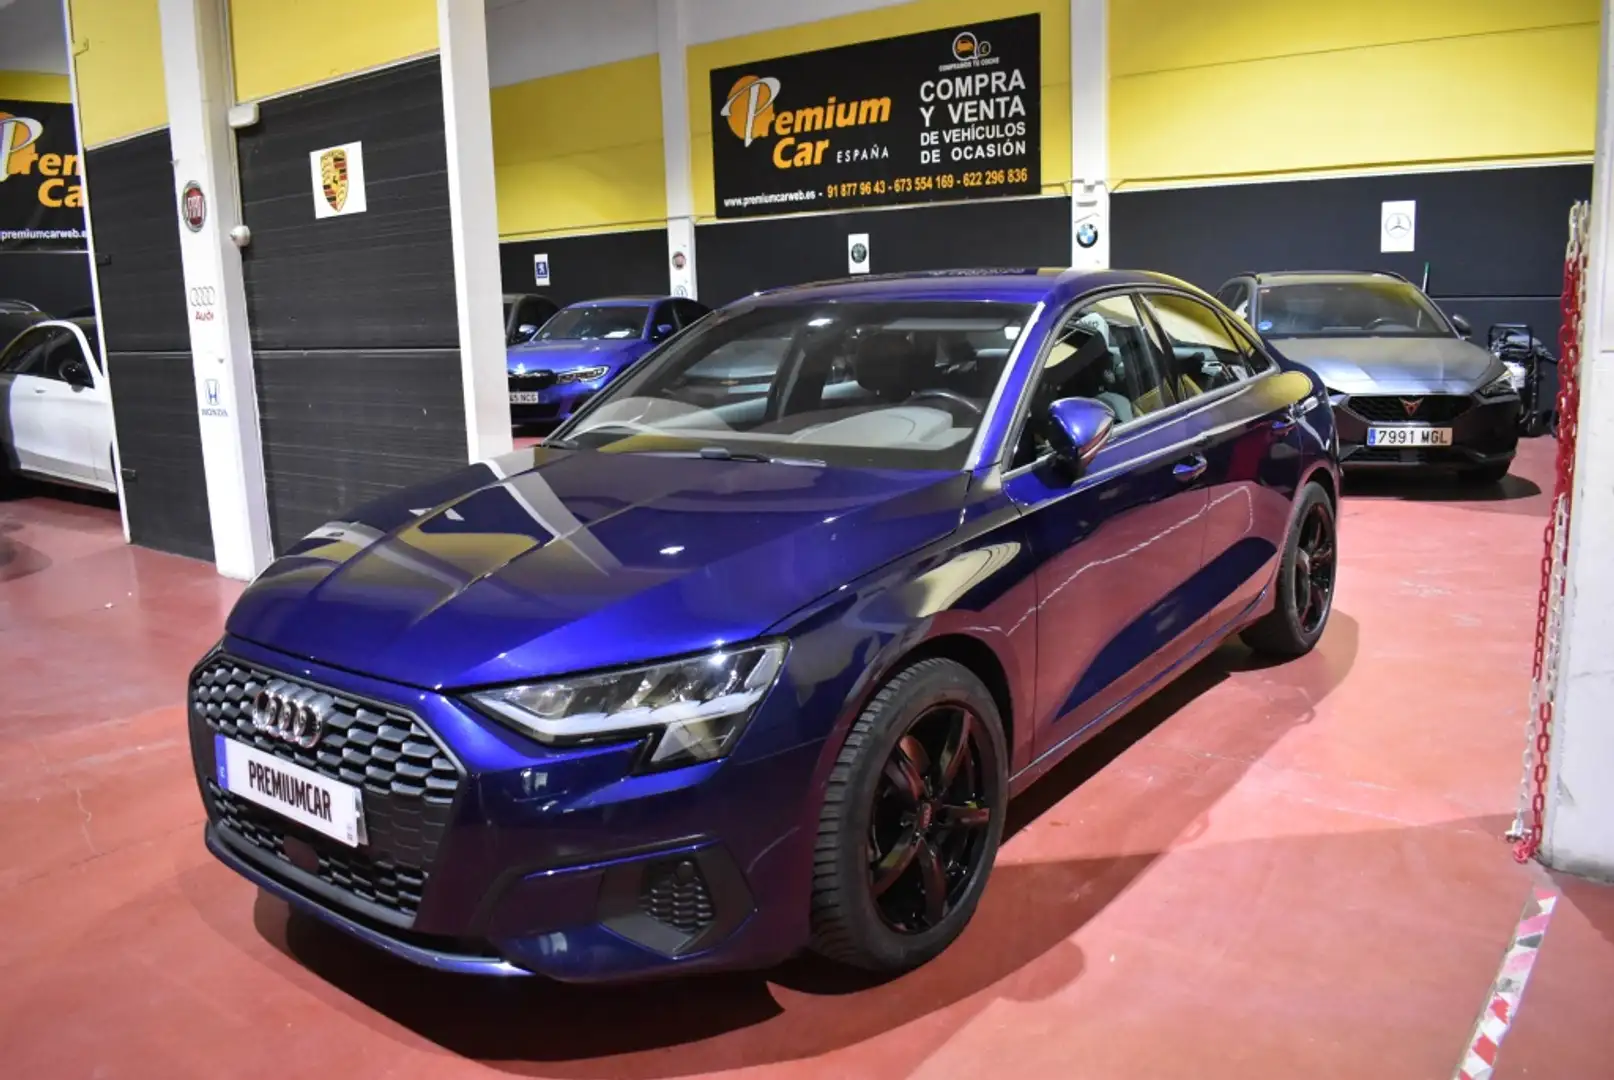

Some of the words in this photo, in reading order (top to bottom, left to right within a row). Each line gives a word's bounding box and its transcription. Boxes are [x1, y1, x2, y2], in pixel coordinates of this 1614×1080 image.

[920, 69, 1026, 102] COMPRA
[720, 77, 891, 147] Premium
[920, 106, 935, 127] Y
[948, 95, 1026, 124] VENTA
[920, 131, 939, 146] DE
[942, 123, 1026, 144] VEHÍCULOS
[773, 137, 830, 168] Car
[836, 144, 889, 163] ESPAÑA
[920, 149, 941, 164] DE
[951, 138, 1026, 161] OCASIÓN
[723, 190, 816, 208] www.premiumcarweb.es
[827, 184, 839, 198] 91
[840, 183, 857, 197] 877
[860, 182, 871, 195] 96
[873, 180, 886, 194] 43
[894, 178, 913, 193] 673
[914, 176, 933, 191] 554
[935, 174, 954, 189] 169
[963, 172, 982, 187] 622
[985, 169, 1005, 185] 296
[1007, 167, 1028, 182] 836
[195, 311, 214, 321] Audi
[201, 408, 228, 417] HONDA
[1378, 430, 1415, 444] 7991
[1421, 430, 1448, 444] MGL
[248, 760, 333, 822] PREMIUMCAR
